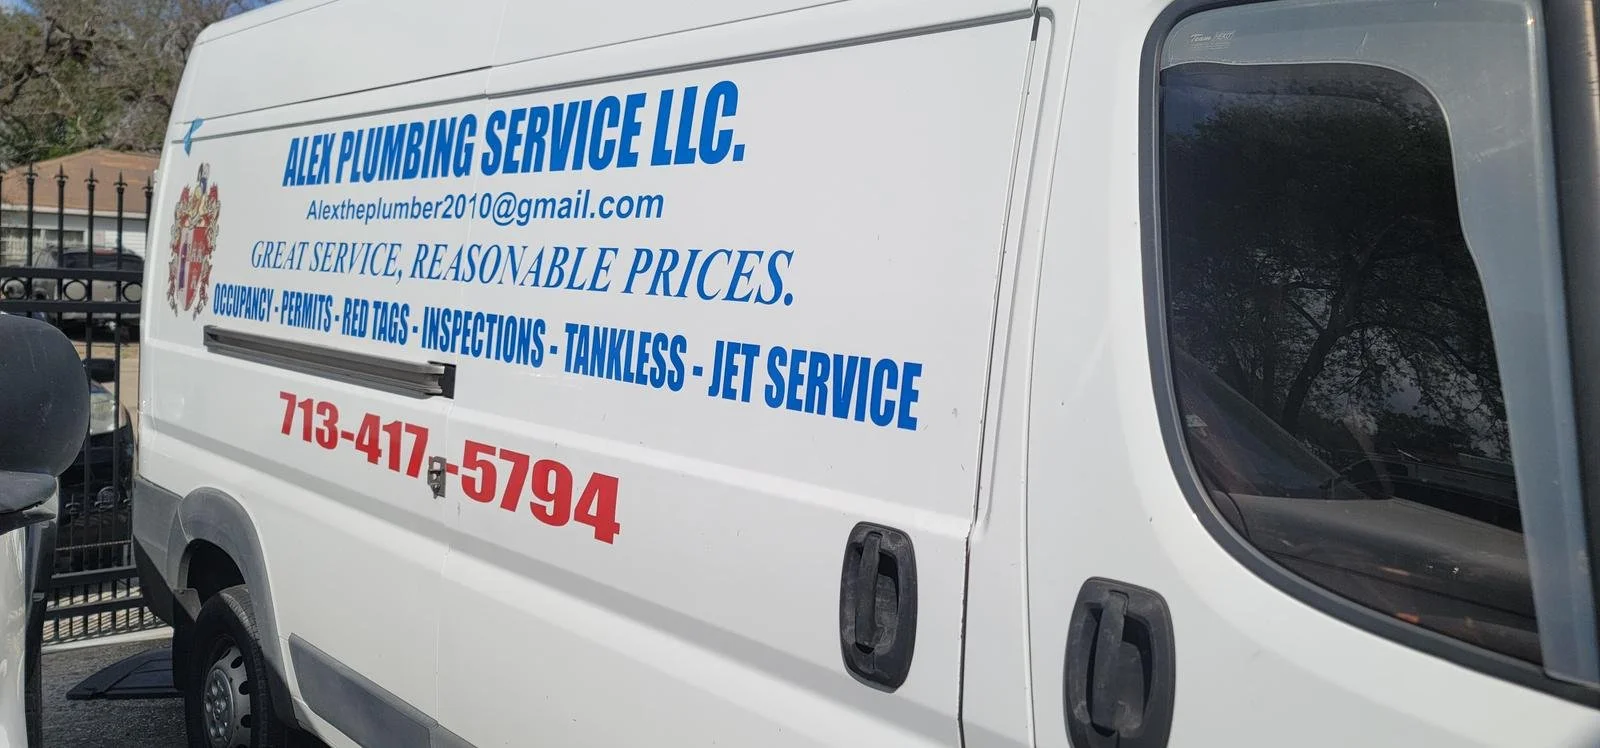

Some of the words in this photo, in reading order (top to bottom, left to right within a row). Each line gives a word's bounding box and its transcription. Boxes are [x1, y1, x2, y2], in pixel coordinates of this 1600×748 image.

[282, 132, 336, 188] ALEX
[335, 114, 477, 185] PLUMBING
[481, 93, 647, 176] SERVICE
[651, 81, 745, 167] LLC.
[306, 190, 664, 227] Alextheplumber2010@gmail.com
[251, 240, 309, 271] GREAT
[308, 241, 403, 286] SERVICE,
[409, 243, 619, 292] REASONABLE
[621, 249, 794, 306] PRICES.
[213, 284, 274, 321] OCCUPANCY
[281, 291, 333, 333] PERMITS
[341, 298, 370, 338] RED
[372, 301, 410, 346] TAGS
[421, 306, 546, 368] INSPECTIONS
[564, 322, 687, 392] TANKLESS
[707, 340, 761, 404] JET
[765, 346, 923, 431] SERVICE
